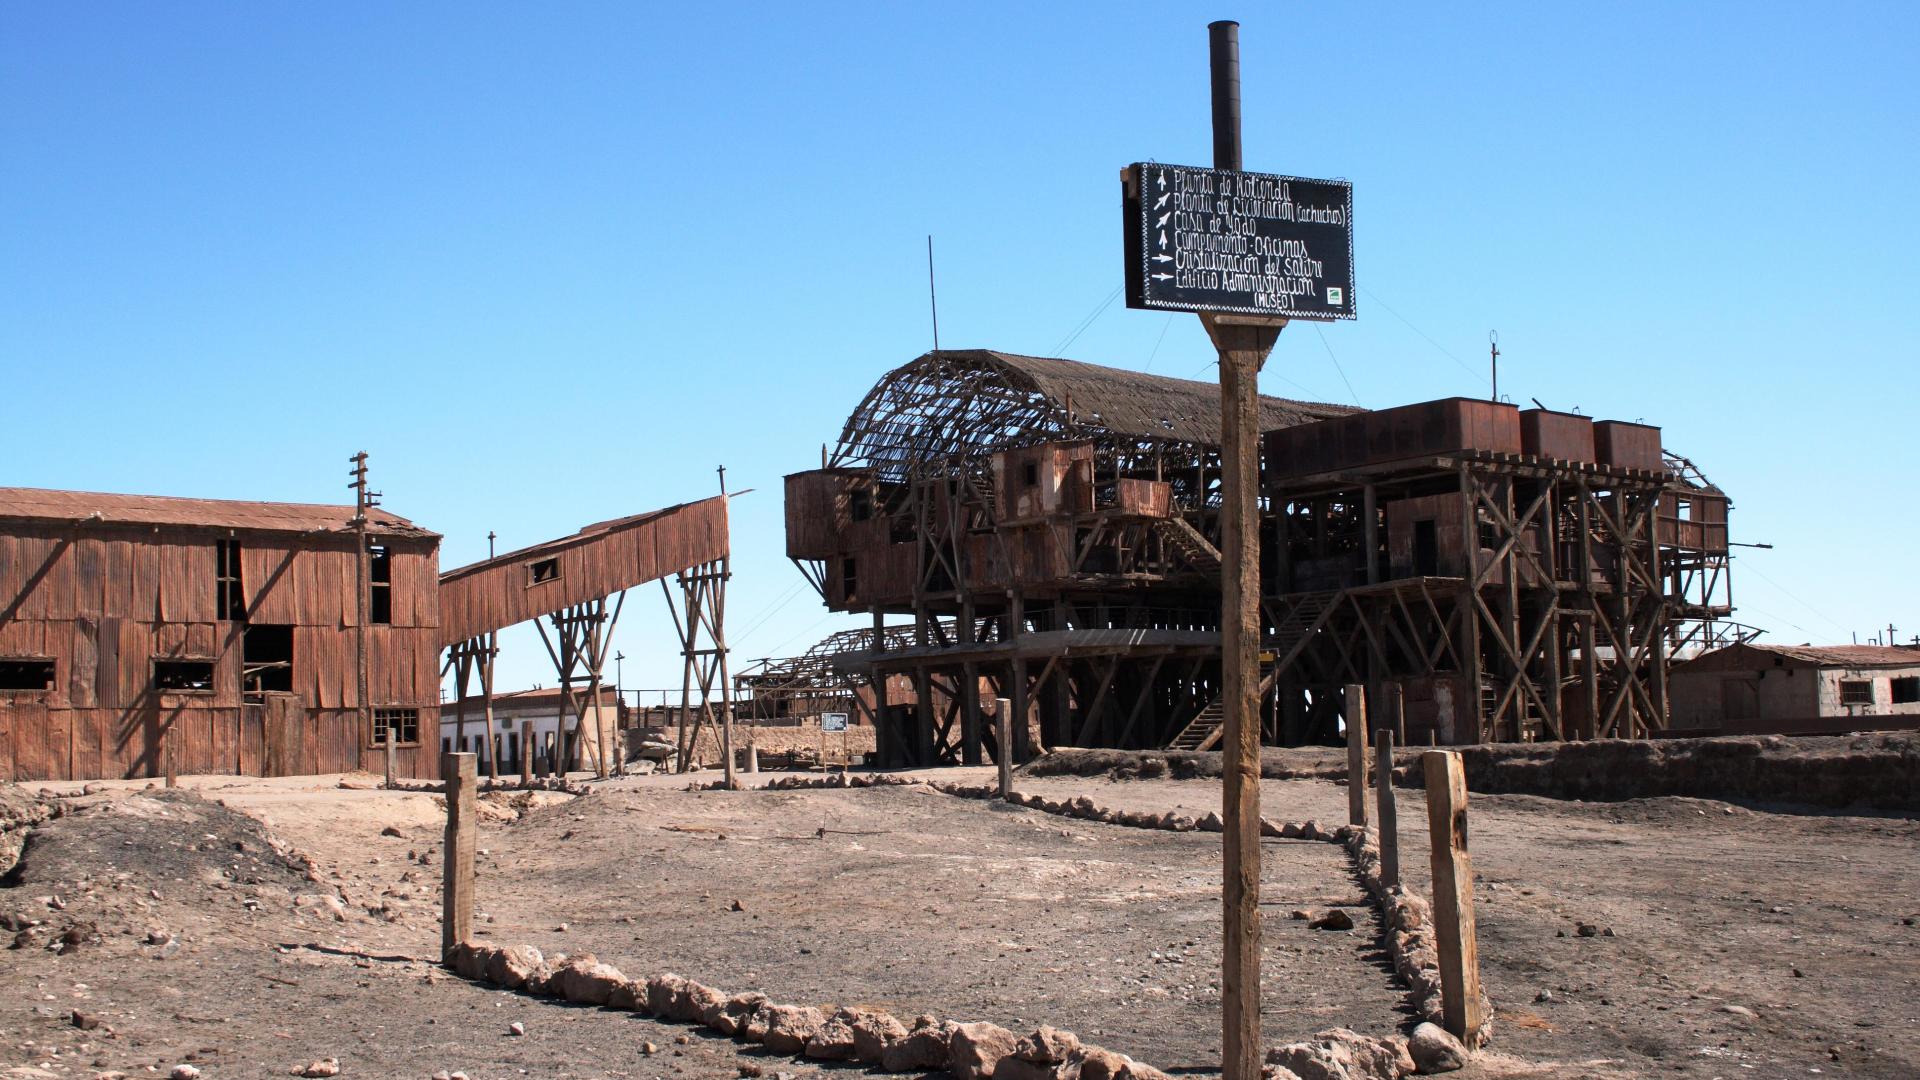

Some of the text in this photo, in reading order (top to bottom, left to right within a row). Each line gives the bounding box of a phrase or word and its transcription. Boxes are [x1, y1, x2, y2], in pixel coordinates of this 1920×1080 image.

[1174, 169, 1291, 201] Planta de Molienda
[1174, 191, 1213, 214] Planta
[1217, 195, 1229, 215] de
[1174, 210, 1256, 236] Casa de Yodo
[1264, 254, 1280, 276] del
[1283, 257, 1323, 279] Salitre
[1175, 269, 1218, 290] Edificio
